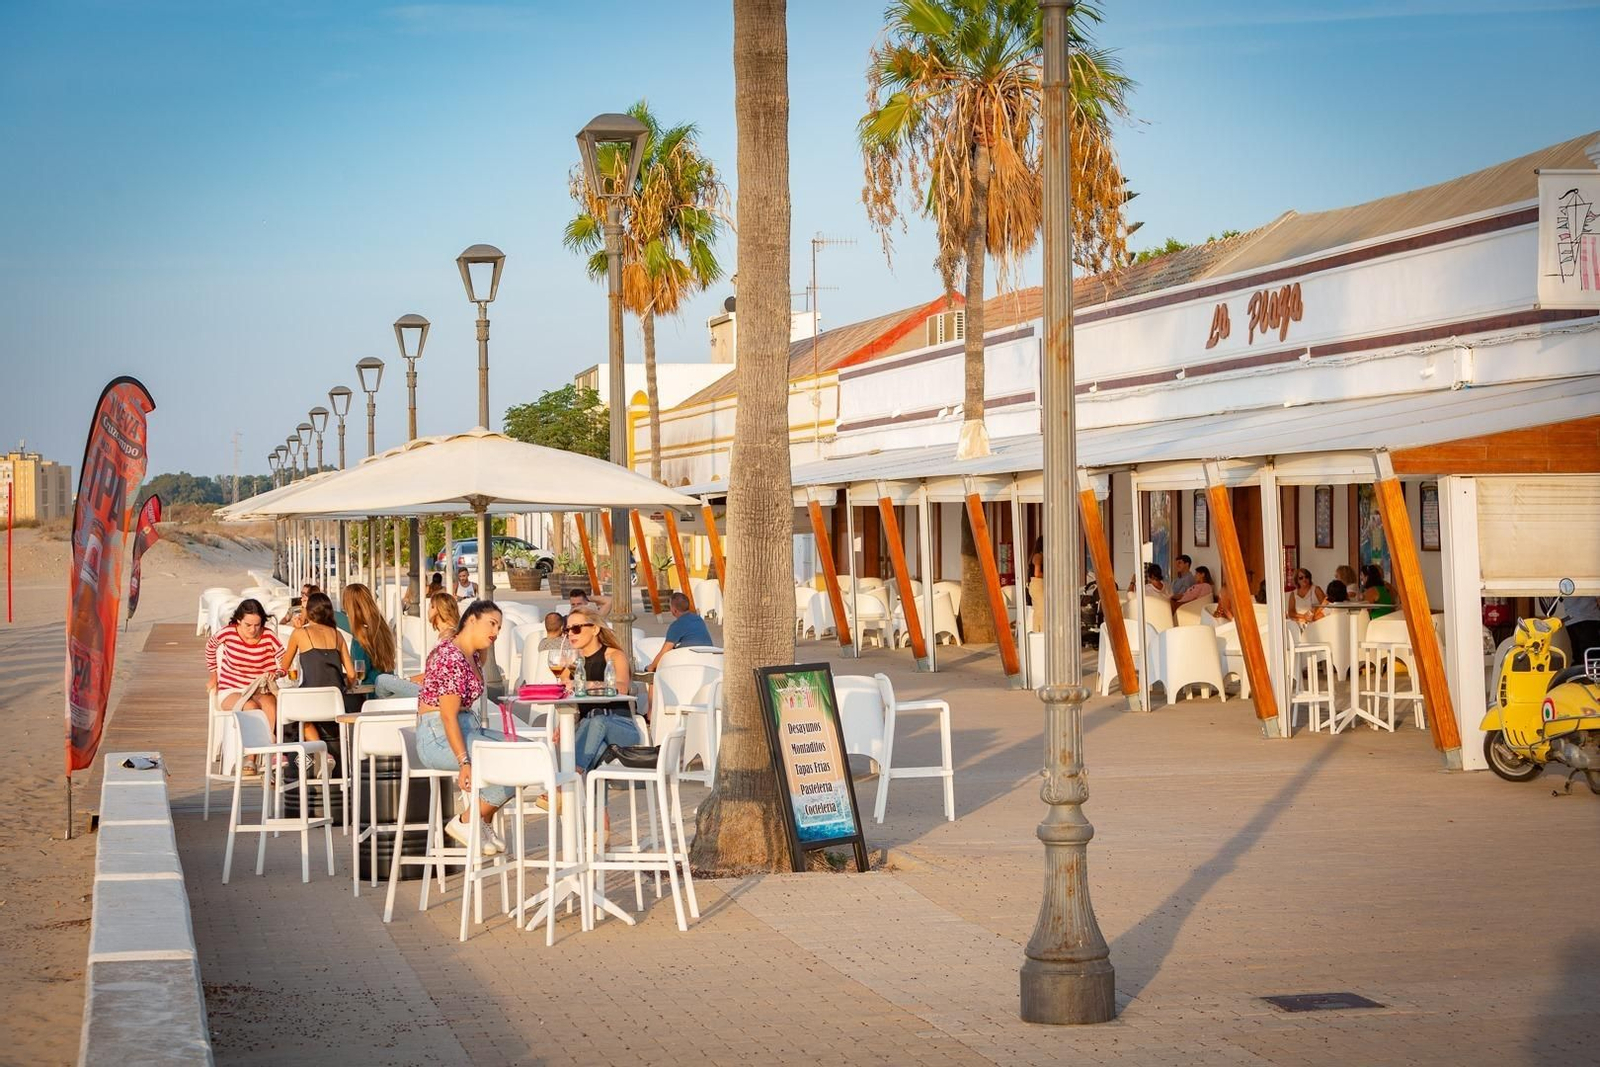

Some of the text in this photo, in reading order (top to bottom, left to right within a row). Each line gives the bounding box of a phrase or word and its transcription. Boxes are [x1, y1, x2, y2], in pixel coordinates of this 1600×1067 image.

[1247, 282, 1304, 346] Playa
[88, 448, 127, 532] IPA
[787, 722, 822, 735] Desayunos
[791, 741, 826, 755] Montaditos
[795, 764, 814, 776] Tapas
